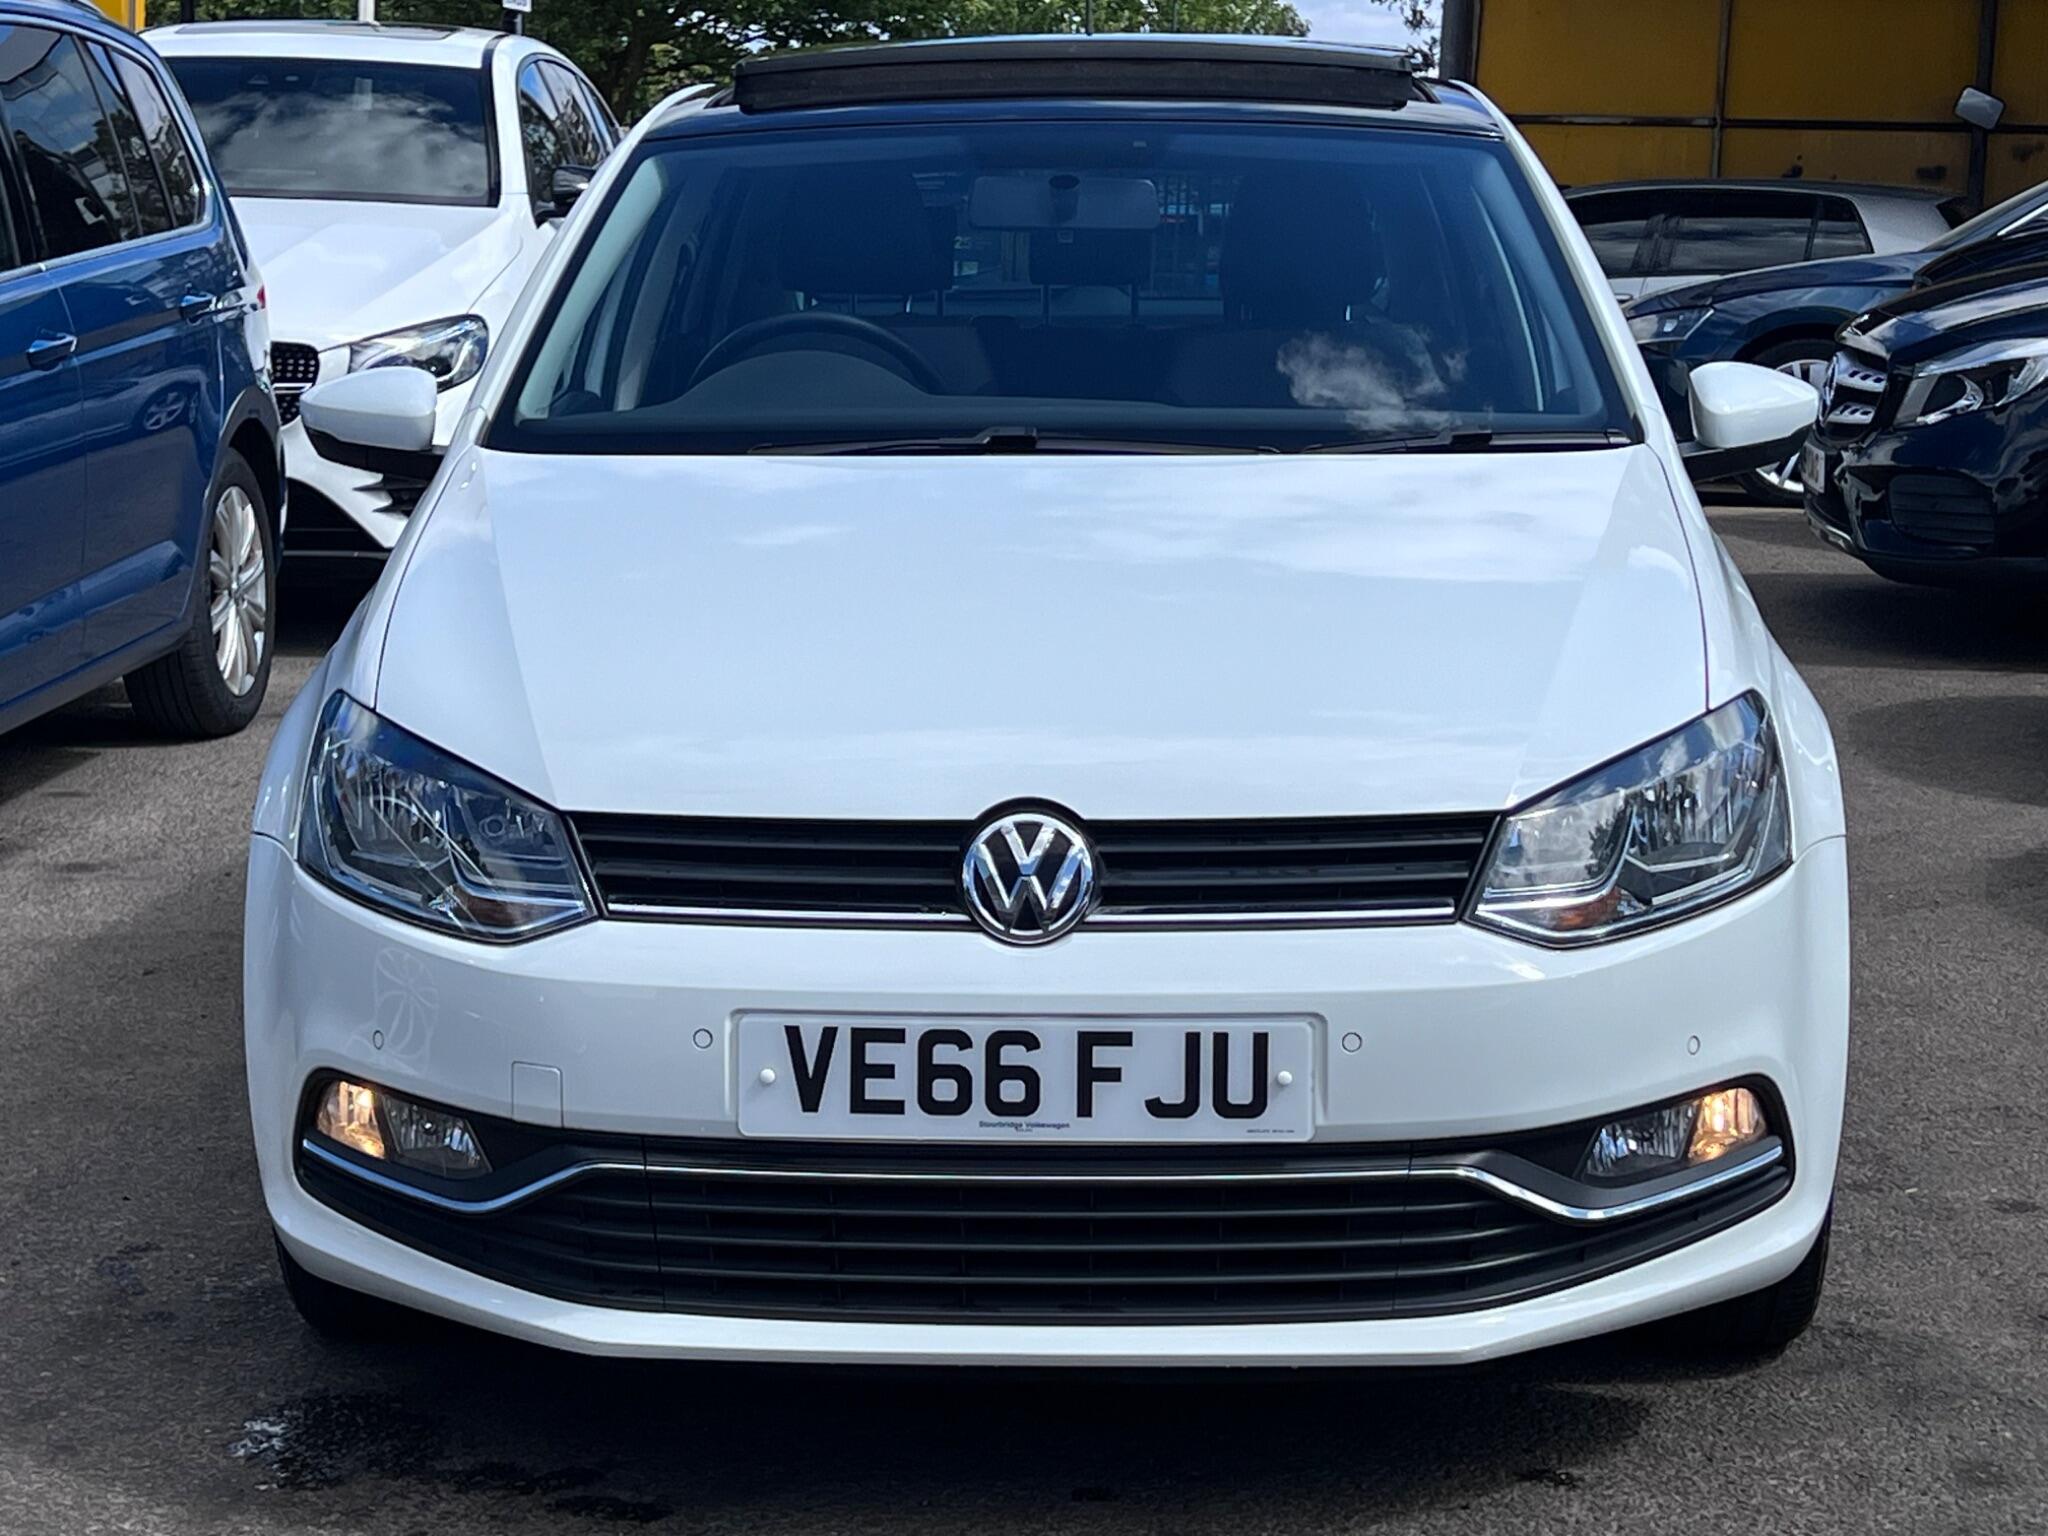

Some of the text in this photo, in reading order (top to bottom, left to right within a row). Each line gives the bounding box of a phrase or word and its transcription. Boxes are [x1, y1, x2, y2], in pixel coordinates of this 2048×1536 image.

[964, 812, 1092, 943] VW
[784, 1025, 1269, 1119] VE66 FJU
[979, 1120, 1070, 1130] Stourbridge Volkswagen
